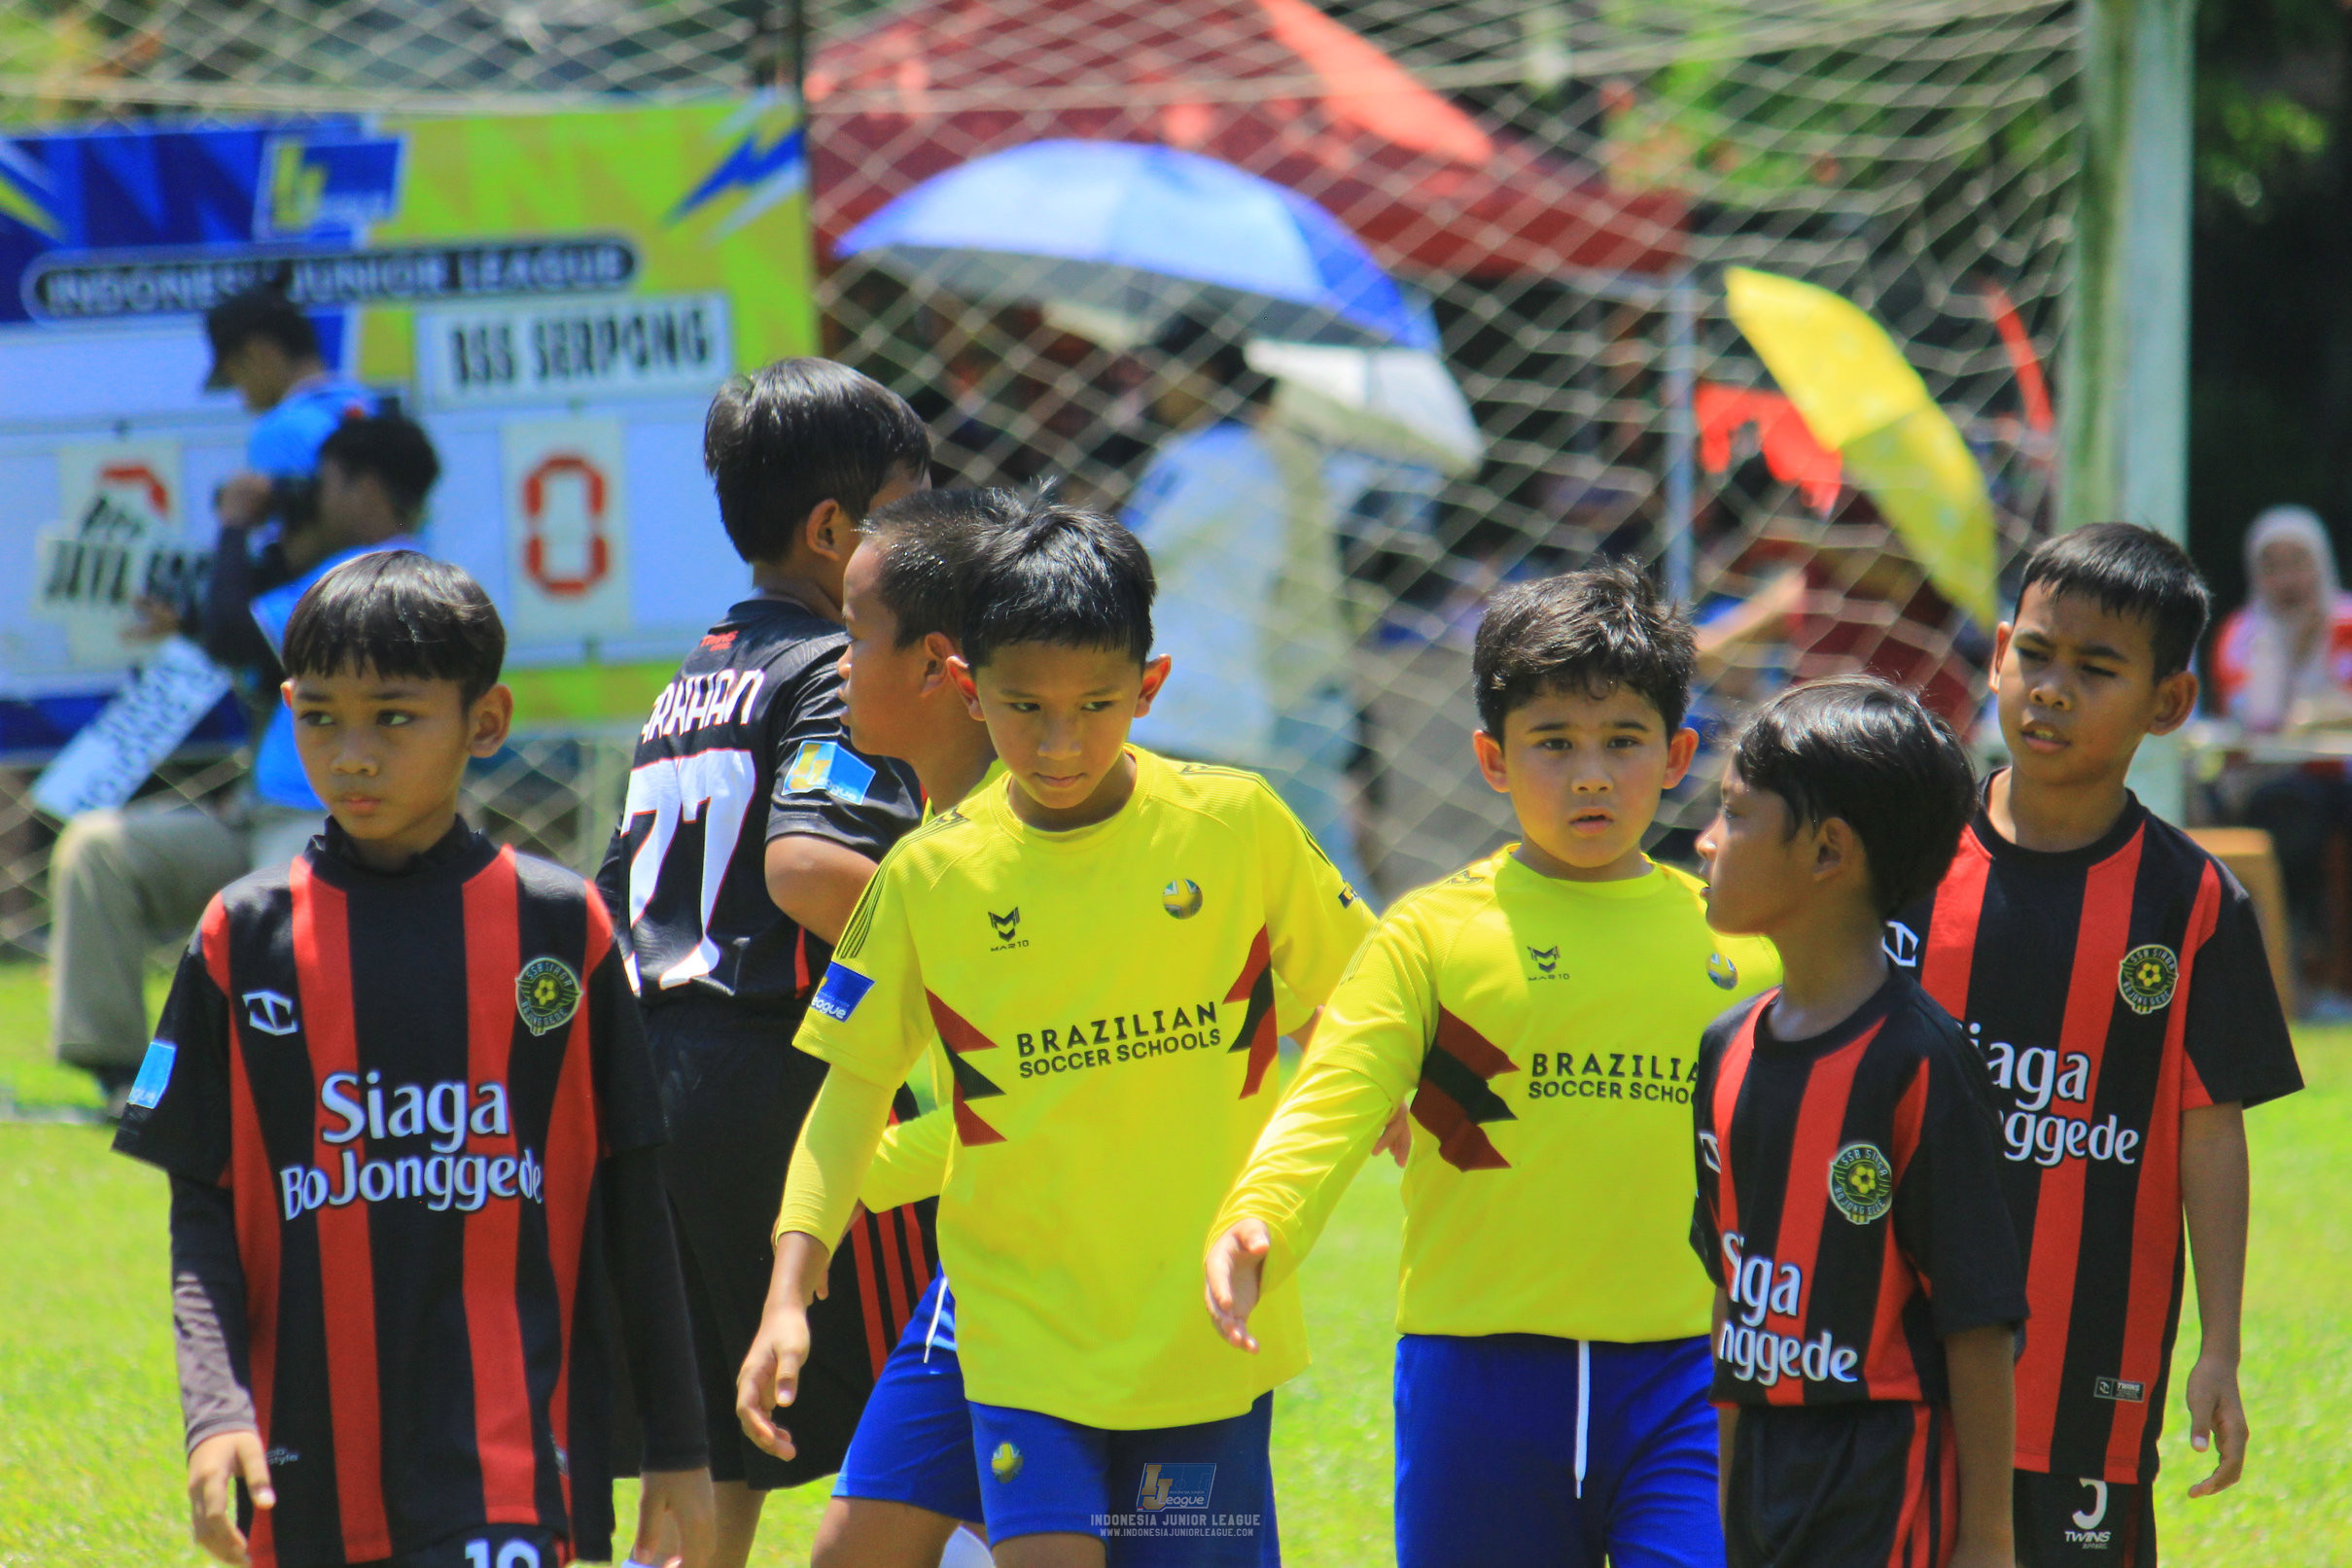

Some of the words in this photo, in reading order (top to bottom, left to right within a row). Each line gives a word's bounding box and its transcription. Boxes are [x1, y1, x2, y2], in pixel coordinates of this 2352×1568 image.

[290, 256, 447, 302] JUNIOR
[457, 245, 620, 290] LEAGUE
[1016, 1001, 1218, 1058] BRAZILIAN
[1019, 1048, 1111, 1079] SOCCER
[1116, 1028, 1222, 1062] SCHOOLS
[320, 1069, 511, 1154] Siaga
[1527, 1080, 1624, 1099] SOCCER
[1629, 1081, 1695, 1105] SCHO
[1999, 1109, 2141, 1167] ggede
[2064, 1531, 2112, 1543] TWINS
